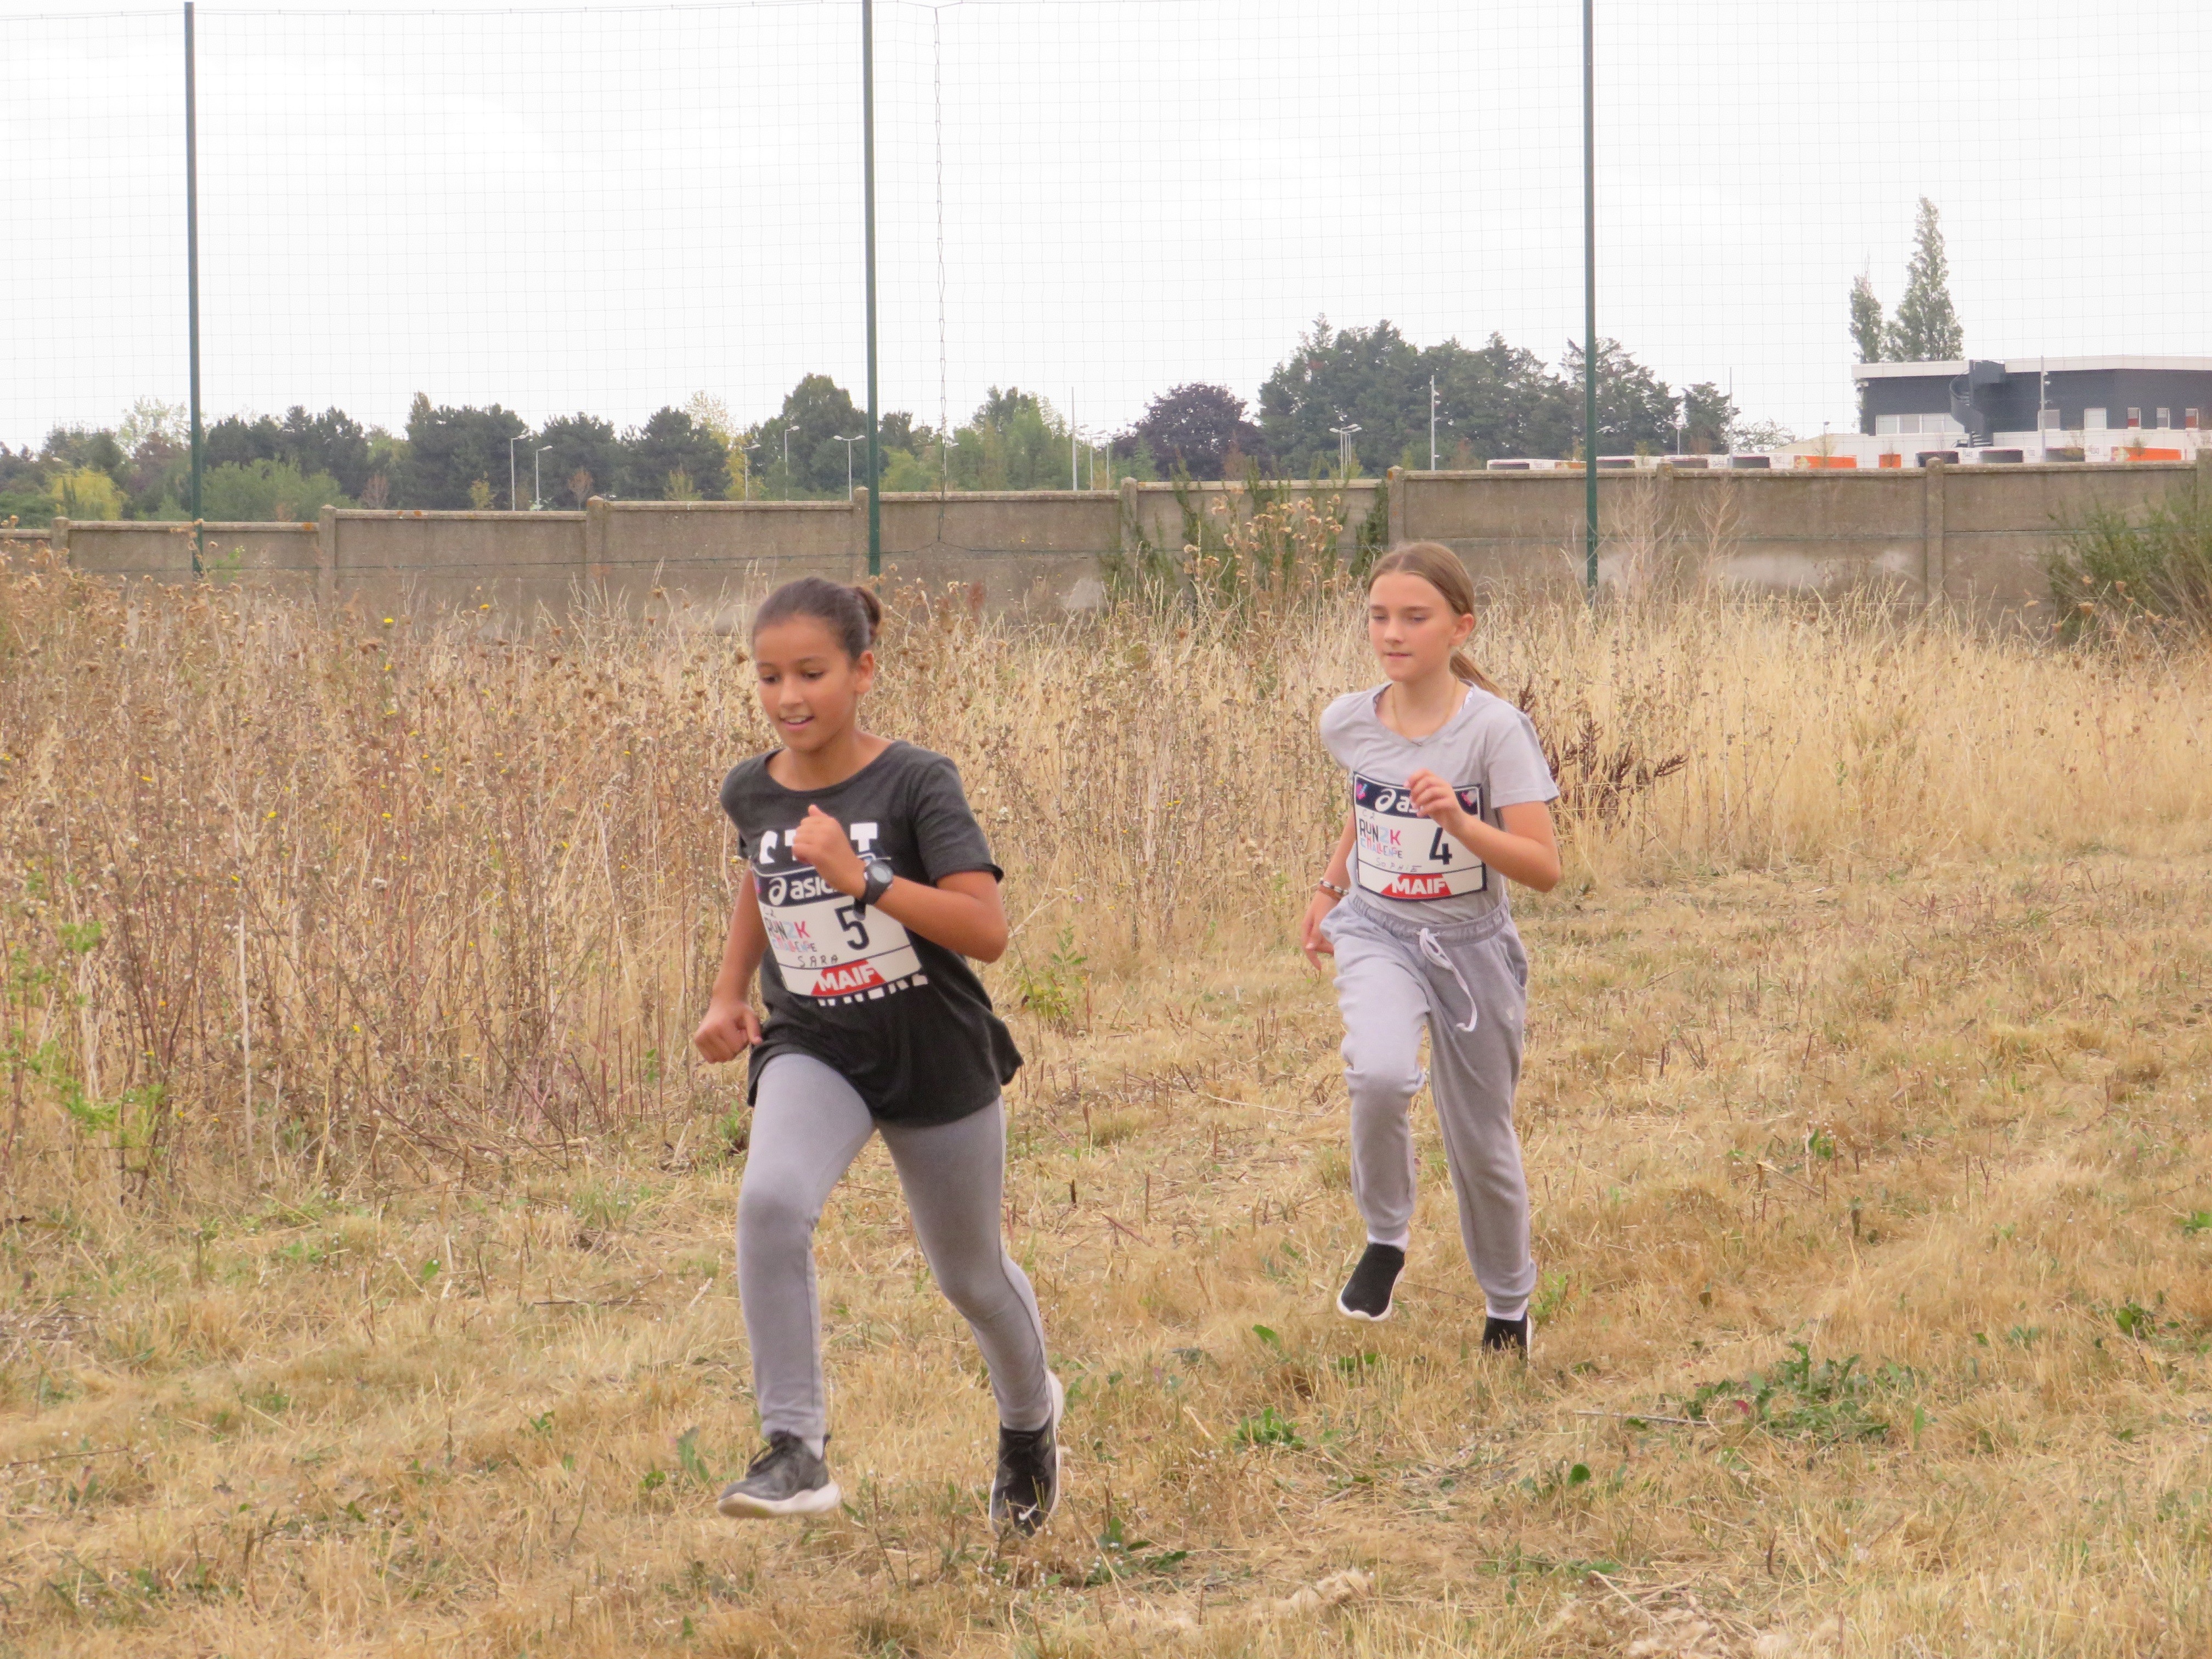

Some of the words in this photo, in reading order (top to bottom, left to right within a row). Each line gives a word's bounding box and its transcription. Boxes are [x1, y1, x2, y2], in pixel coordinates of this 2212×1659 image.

[1359, 818, 1401, 846] RUN2K
[1429, 827, 1453, 865] 4
[789, 877, 838, 900] asic
[1392, 877, 1446, 895] MAIF
[834, 904, 870, 951] 5
[797, 953, 838, 968] SARA
[817, 964, 876, 992] MAIF
